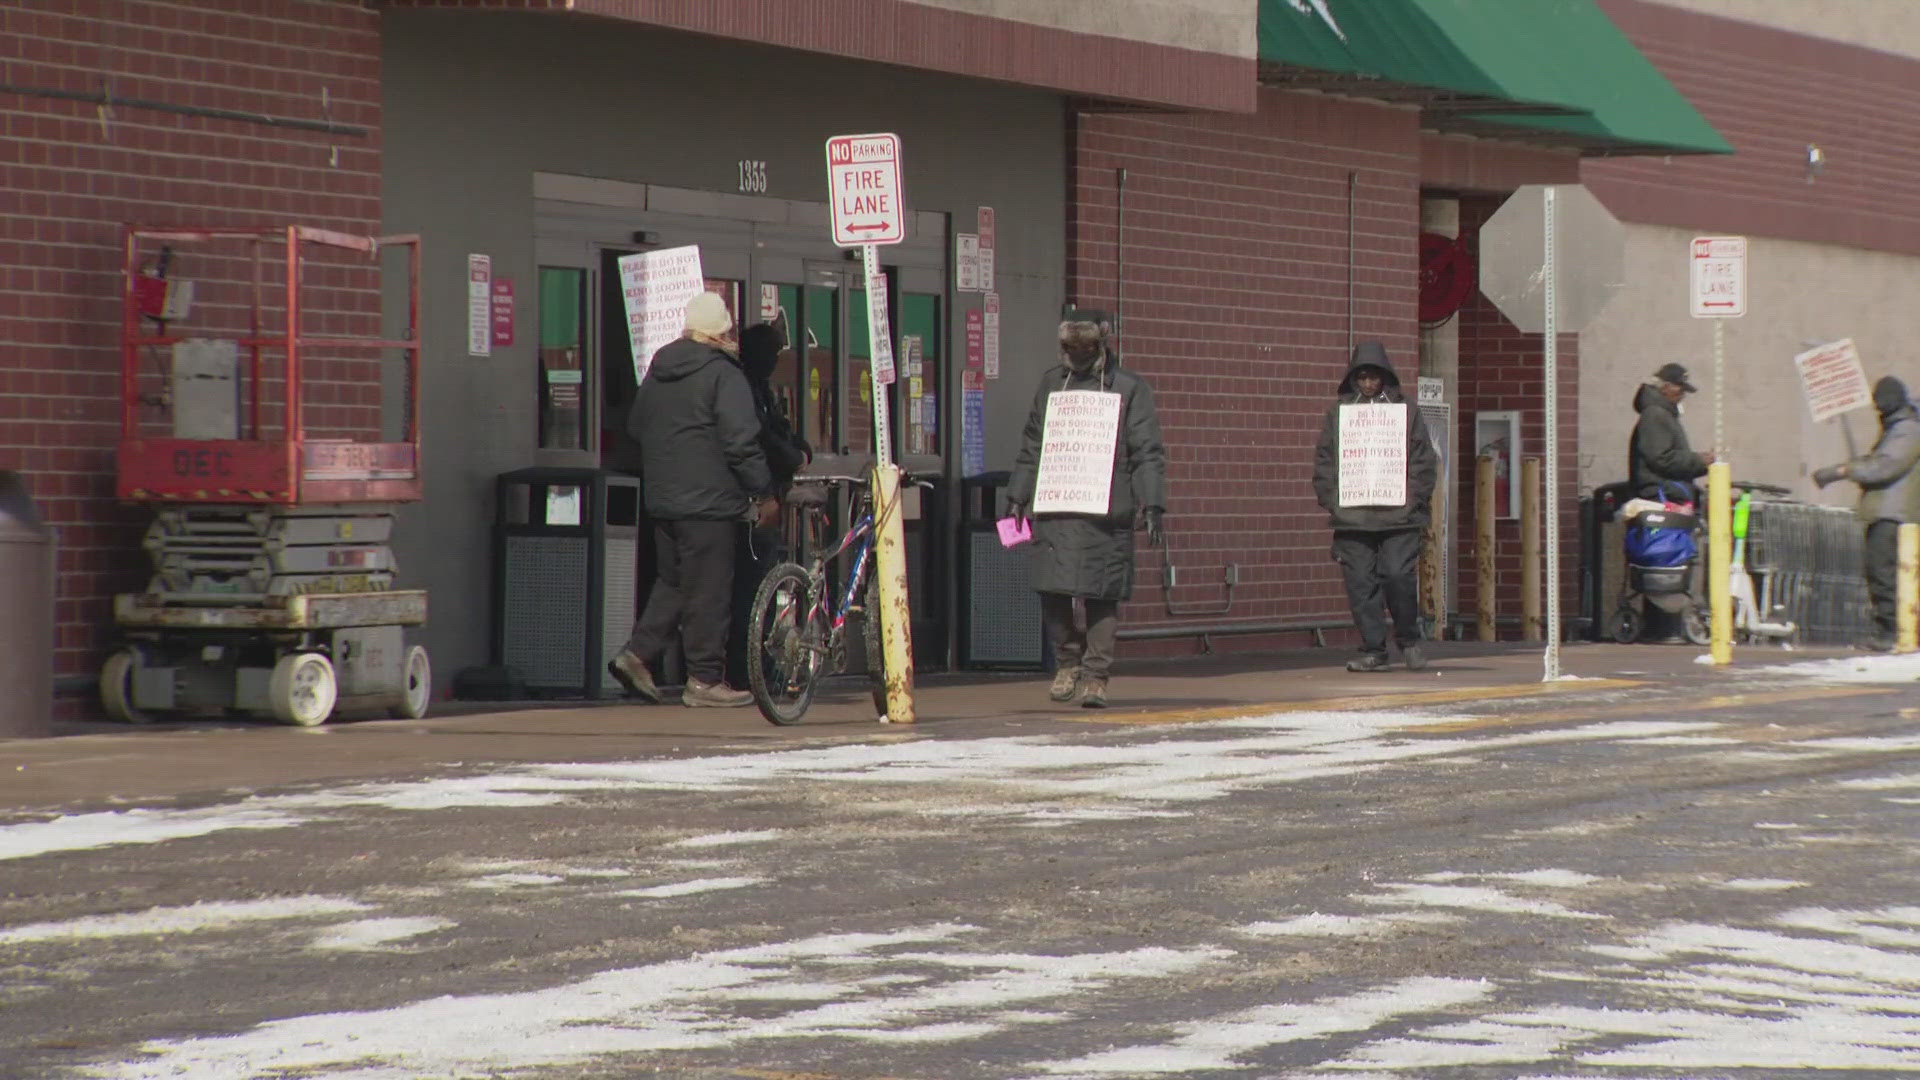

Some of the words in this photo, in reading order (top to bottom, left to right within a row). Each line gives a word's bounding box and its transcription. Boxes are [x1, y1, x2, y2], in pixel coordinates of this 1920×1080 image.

[832, 143, 850, 163] NO
[853, 142, 893, 159] PARKING
[738, 160, 767, 192] 1355
[844, 169, 885, 191] FIRE
[843, 194, 890, 216] LANE
[1703, 263, 1734, 277] FIRE
[1702, 280, 1736, 295] LANE
[1050, 396, 1079, 406] PLEASE
[1082, 396, 1096, 405] DO
[1098, 396, 1118, 407] NOT
[1057, 407, 1105, 417] PATRONIZE
[1342, 447, 1403, 459] EMPLOYEES
[1063, 489, 1092, 501] LOCAL
